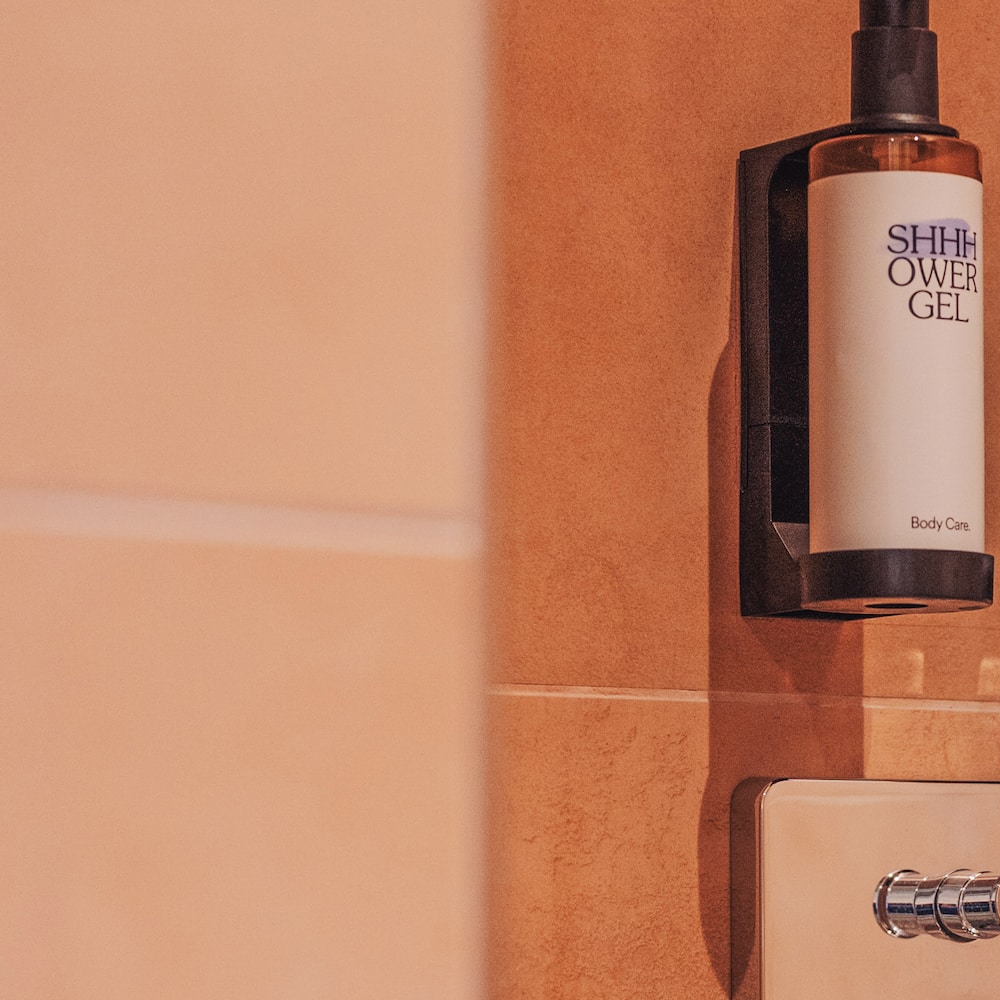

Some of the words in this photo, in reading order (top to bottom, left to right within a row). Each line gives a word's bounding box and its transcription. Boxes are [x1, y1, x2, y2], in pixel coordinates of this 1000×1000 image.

[887, 224, 977, 260] SHHH
[888, 256, 978, 293] OWER
[908, 290, 969, 323] GEL
[911, 516, 943, 532] Body
[945, 517, 971, 531] Care.
